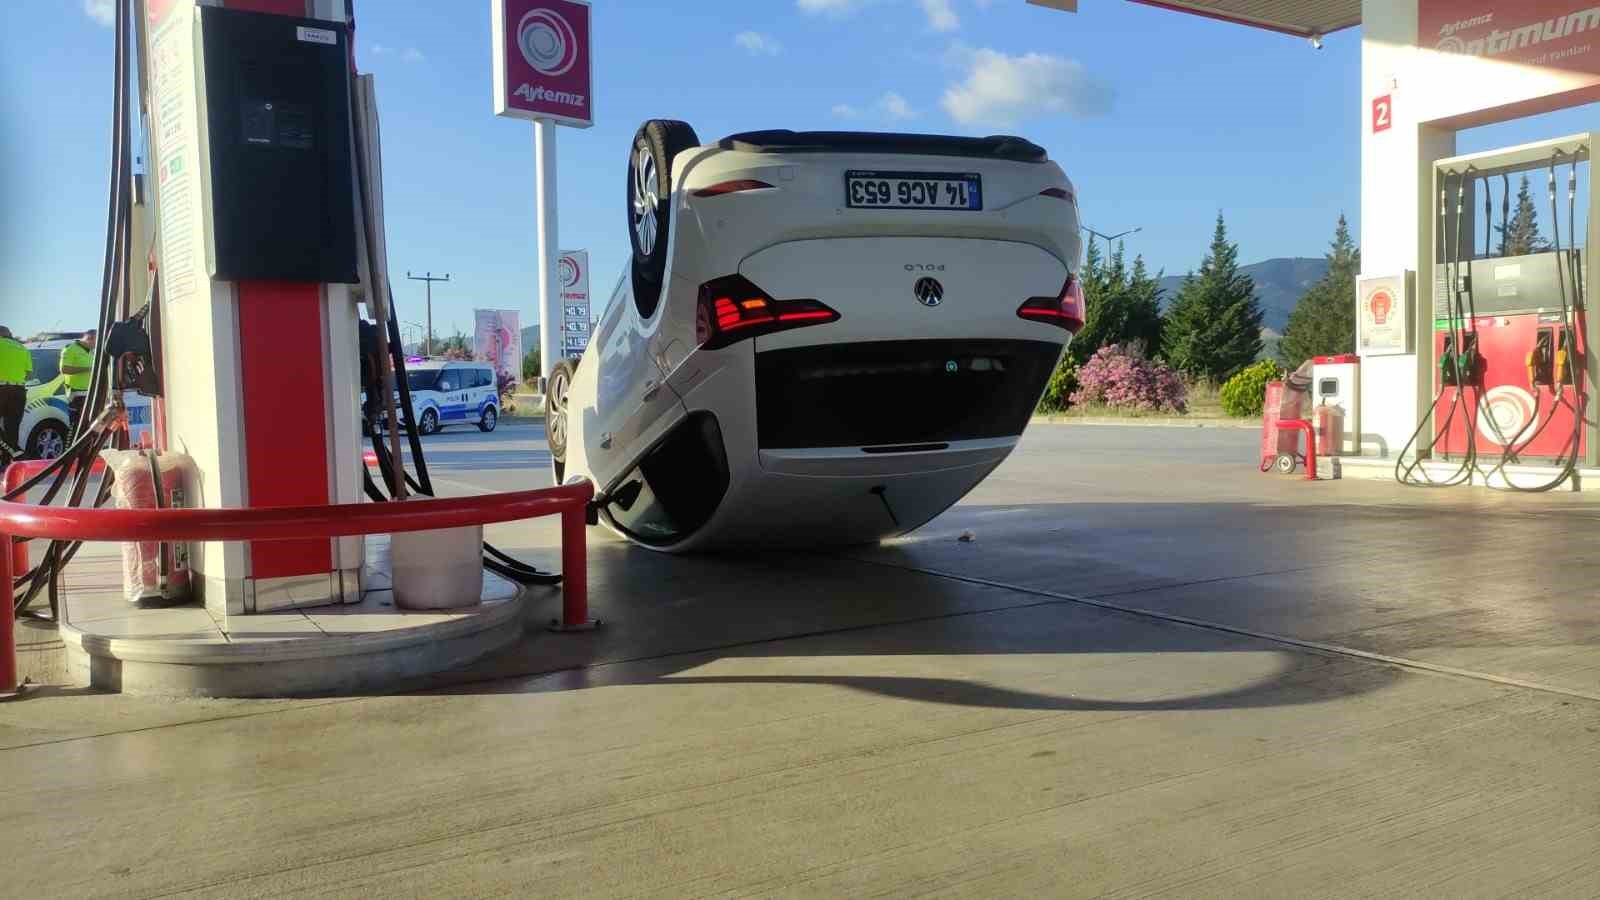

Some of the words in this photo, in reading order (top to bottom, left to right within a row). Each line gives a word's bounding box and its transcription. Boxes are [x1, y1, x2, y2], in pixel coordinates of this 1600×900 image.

[513, 83, 585, 106] Aytemiz
[1376, 103, 1389, 126] 2
[851, 180, 891, 205] 653
[897, 181, 939, 205] ACG
[945, 182, 968, 205] 14
[903, 263, 946, 272] POLO
